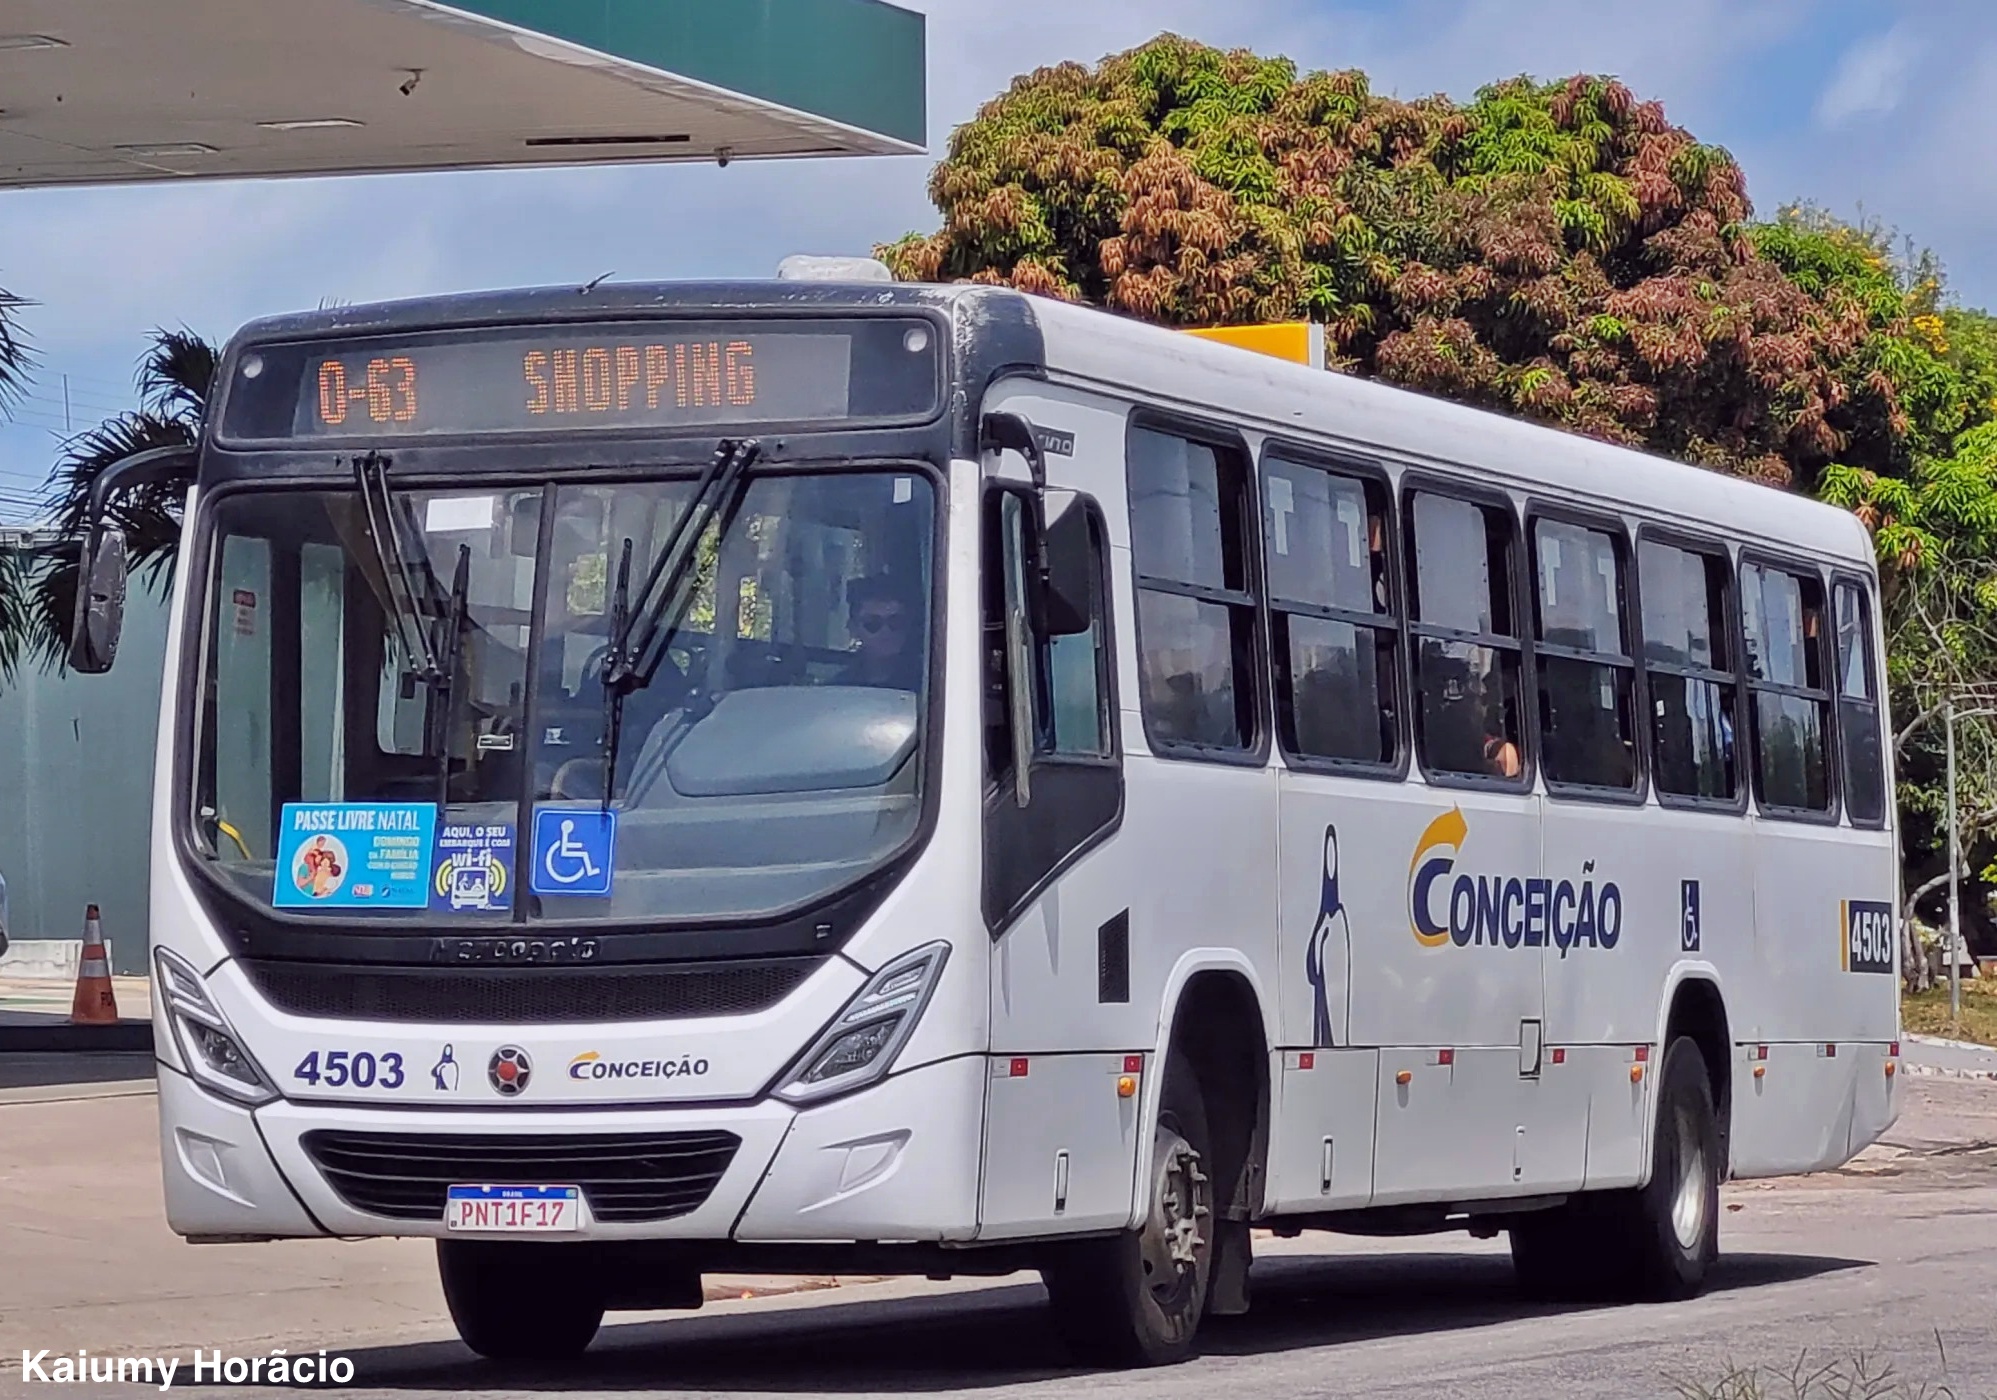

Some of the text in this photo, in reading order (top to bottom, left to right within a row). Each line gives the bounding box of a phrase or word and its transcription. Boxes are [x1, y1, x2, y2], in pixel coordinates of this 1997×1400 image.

[523, 340, 755, 414] SHOPPING
[294, 810, 420, 831] PASSE LIVRE NATAL
[442, 826, 506, 838] AQUI, O SEU
[1411, 857, 1622, 960] CONCEIÇÃO
[1851, 911, 1891, 964] 4503
[294, 1050, 405, 1088] 4503
[567, 1053, 710, 1081] CONCEIÇÃO
[461, 1201, 565, 1227] PNT1F17
